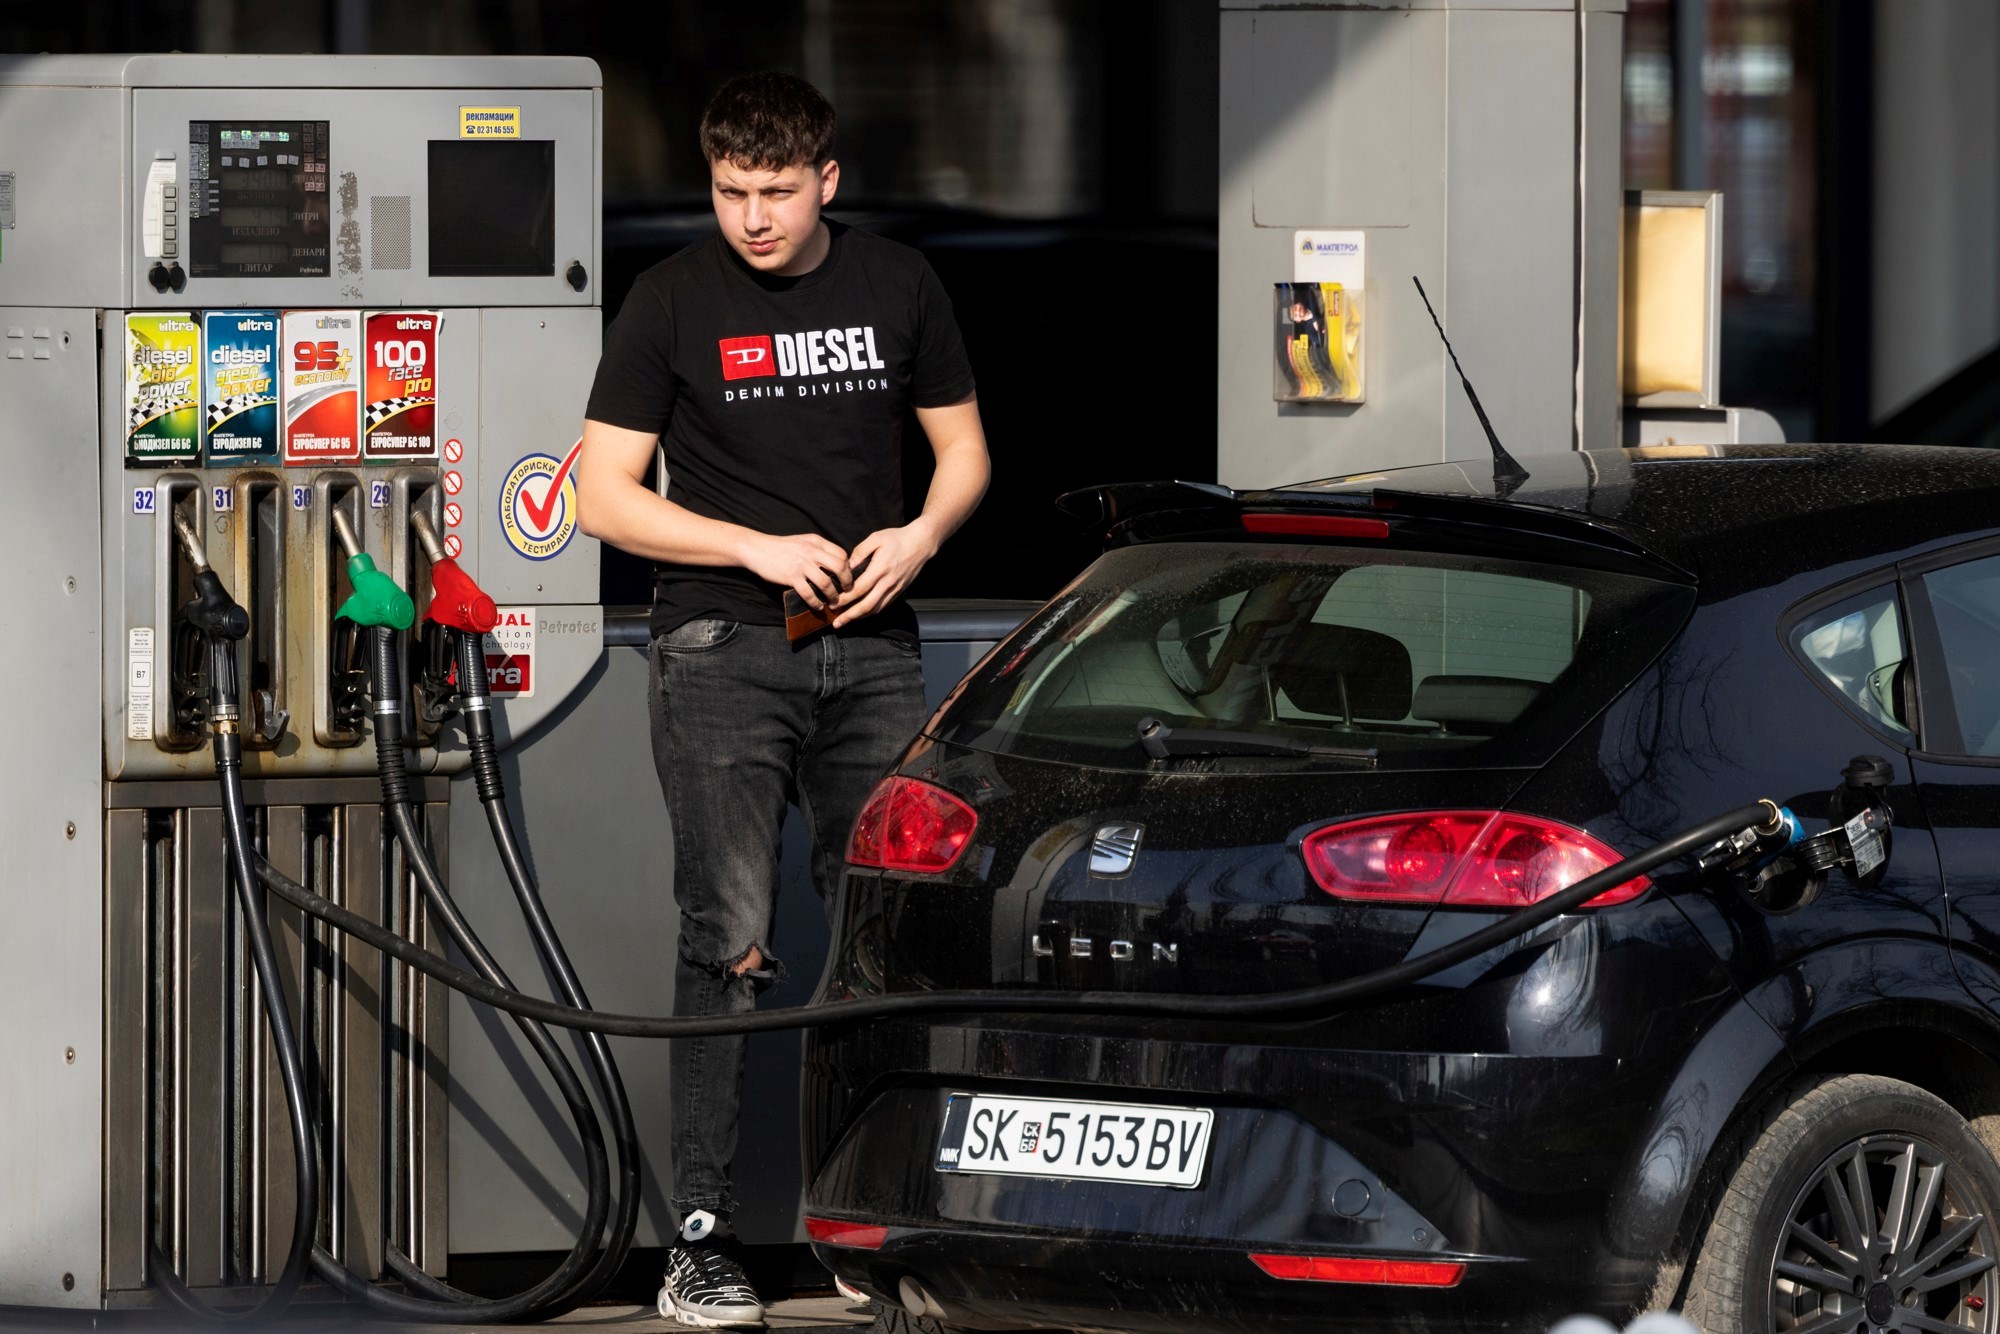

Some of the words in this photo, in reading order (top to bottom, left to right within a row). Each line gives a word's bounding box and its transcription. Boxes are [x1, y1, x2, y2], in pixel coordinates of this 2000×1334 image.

[466, 113, 514, 122] рекламации
[477, 126, 484, 134] 02
[486, 126, 493, 134] 31
[494, 126, 501, 134] 46
[503, 126, 514, 134] 555
[292, 212, 319, 220] ЛИТРИ
[232, 227, 280, 236] ИЗДАДЕНО
[292, 248, 325, 257] ДЕНАРИ
[244, 264, 273, 272] ЛИТАР
[159, 320, 194, 332] ultra
[238, 319, 273, 331] ultra
[316, 316, 351, 329] ultra
[397, 317, 432, 330] ultra
[133, 346, 192, 364] diesel
[212, 345, 270, 363] diesel
[294, 341, 352, 371] 95+
[374, 340, 426, 368] 100
[775, 326, 885, 377] DIESEL
[151, 364, 176, 382] bio
[216, 366, 259, 387] green
[294, 368, 350, 386] economy
[388, 364, 424, 382] race
[139, 380, 191, 403] power
[220, 378, 271, 401] power
[404, 378, 432, 398] pro
[725, 386, 785, 402] DENIM
[798, 378, 888, 397] DIVISION
[182, 438, 191, 449] БС
[213, 438, 251, 450] ЕУРОДИЗЕЛ
[252, 438, 262, 449] БС
[293, 438, 330, 450] ЕУРОСУПЕР
[331, 438, 340, 449] БС
[341, 438, 351, 449] 95
[371, 437, 407, 448] ЕУРОСУПЕР
[408, 436, 417, 448] БС
[418, 436, 430, 448] 100
[135, 490, 153, 510] 32
[215, 489, 231, 508] 31
[294, 488, 312, 507] 30
[373, 485, 391, 504] 29
[504, 462, 556, 529] ЛАБОРАТОРИСКИ
[523, 523, 571, 554] ТЕСТИРАНО
[486, 630, 531, 638] ction
[539, 621, 598, 634] Petrotec
[485, 641, 531, 649] chnology
[136, 671, 146, 679] B7
[1032, 935, 1178, 963] LEON
[968, 1108, 1020, 1162] SK
[940, 1147, 960, 1163] NMK
